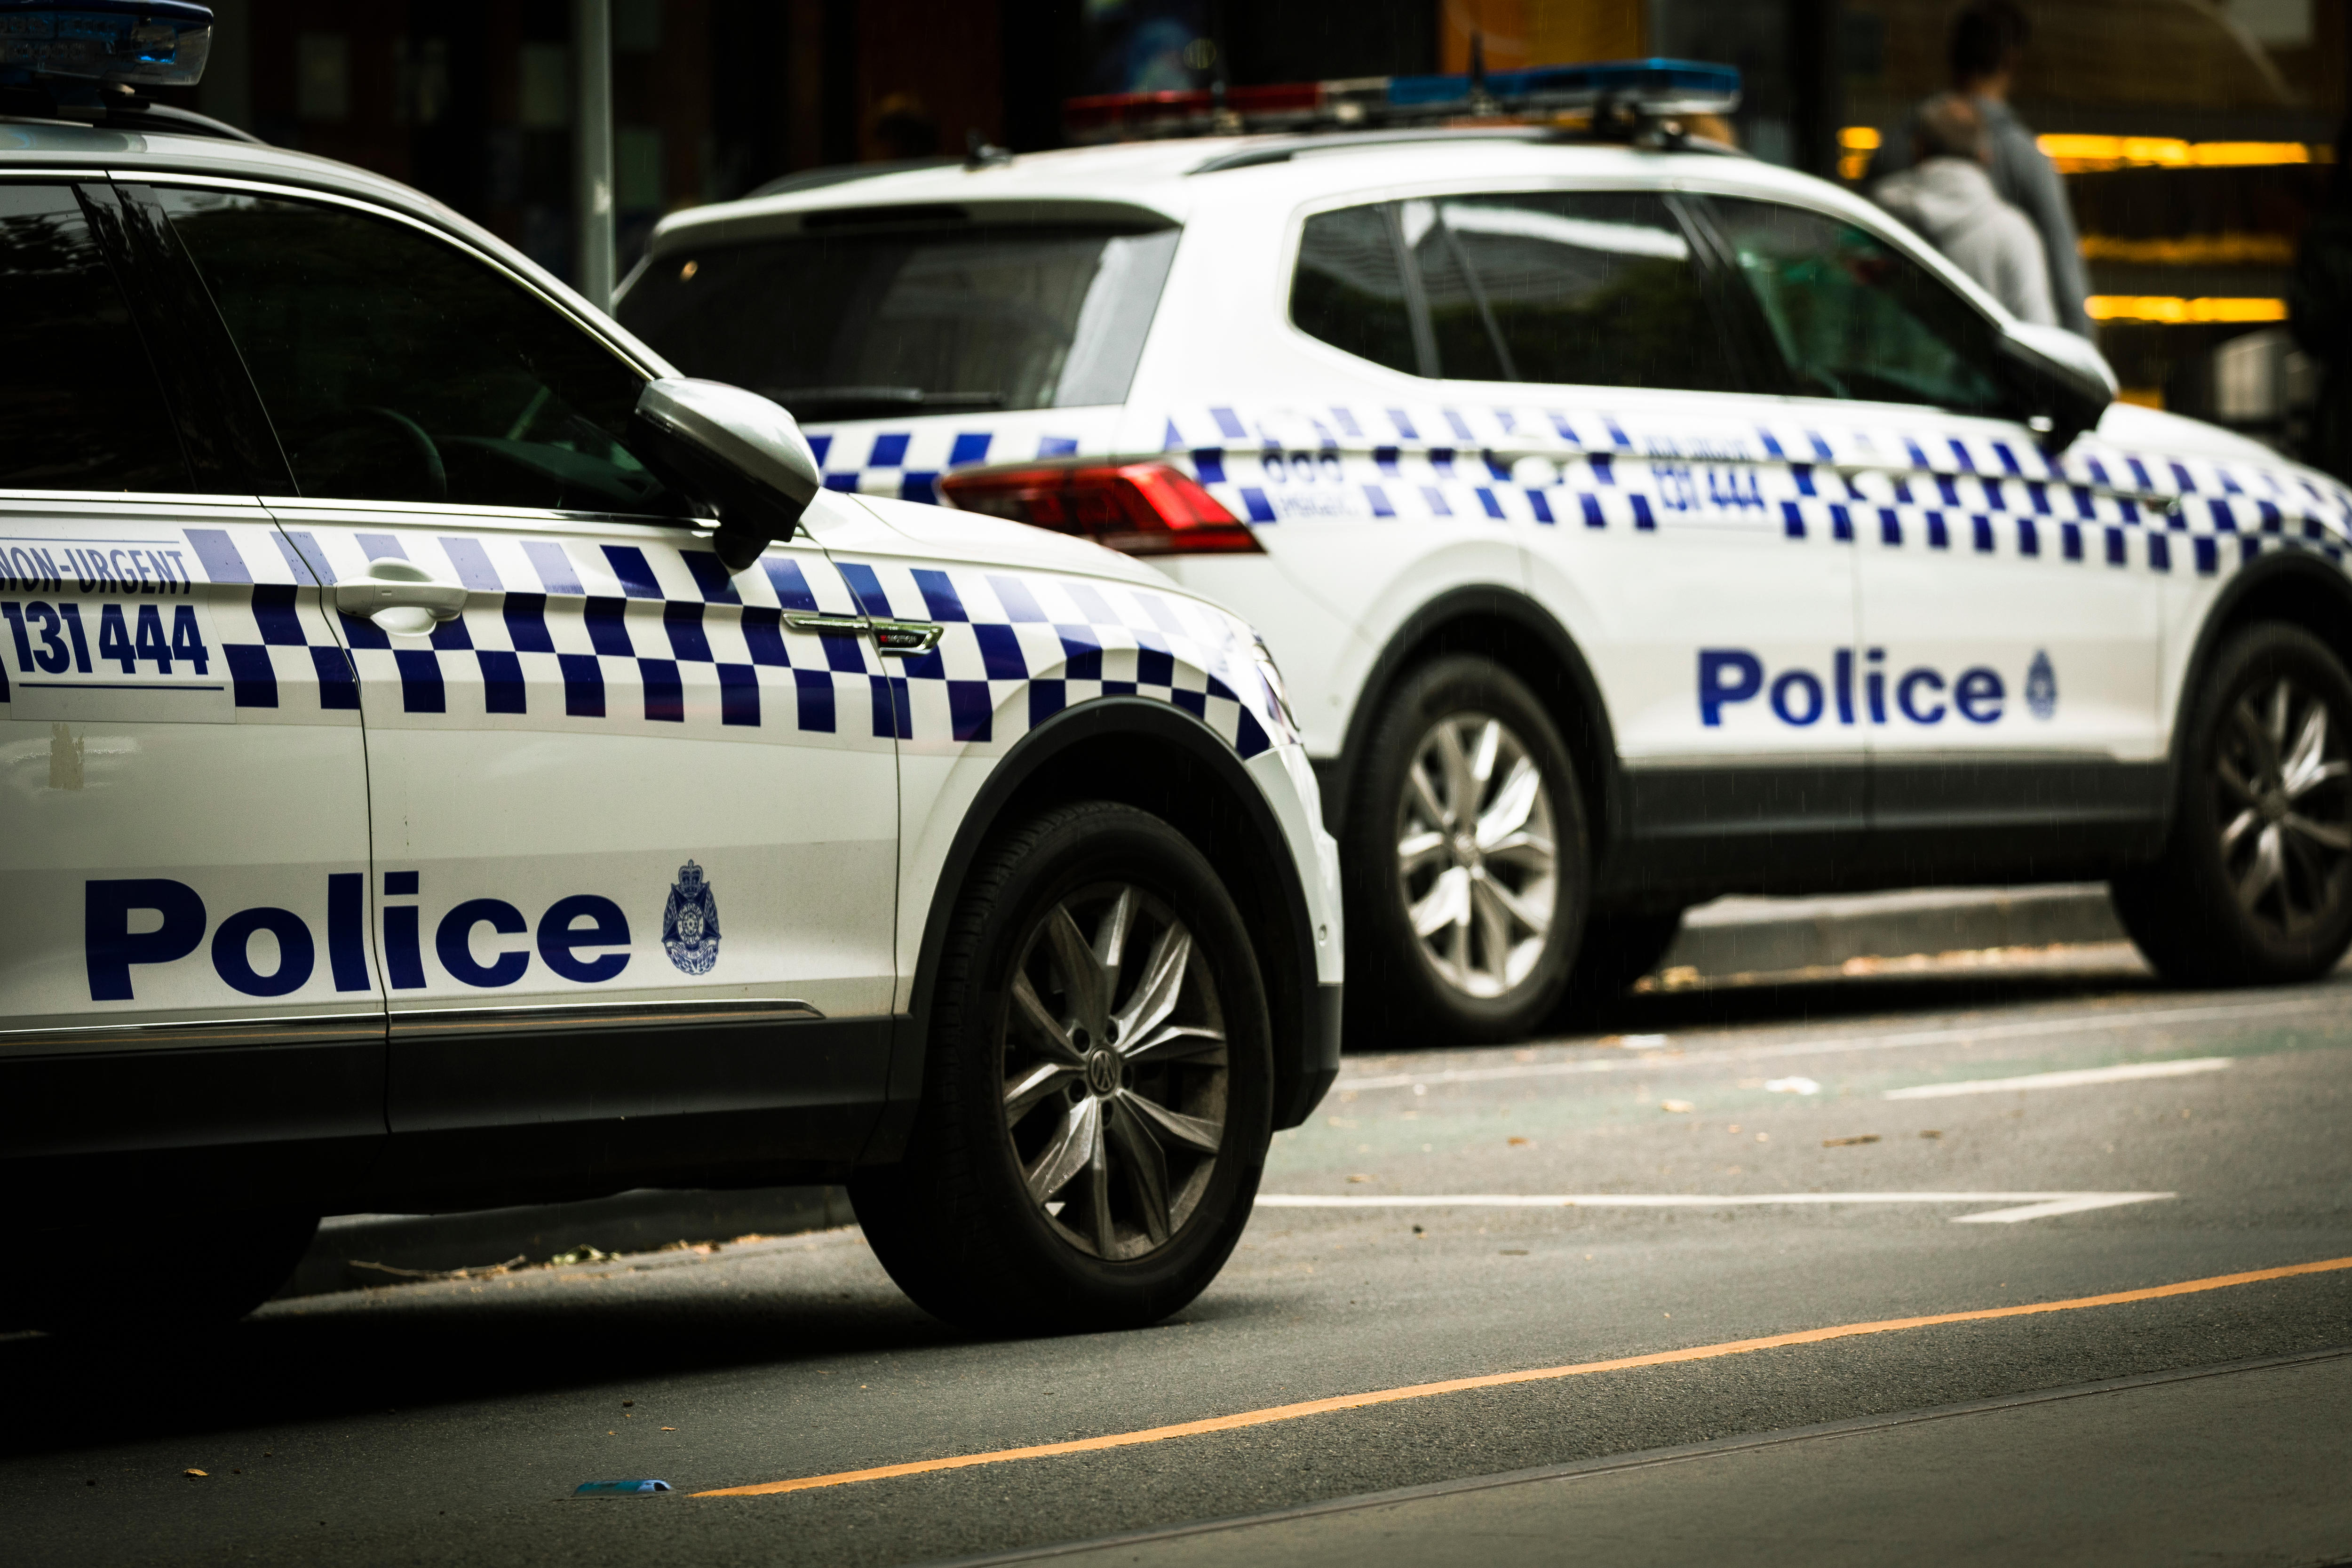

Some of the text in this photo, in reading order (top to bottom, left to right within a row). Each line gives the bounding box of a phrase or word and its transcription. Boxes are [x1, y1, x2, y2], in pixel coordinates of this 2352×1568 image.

[0, 547, 191, 595] NON-URGENT
[0, 601, 209, 675] 131 444
[1697, 646, 2006, 728] Police
[85, 870, 632, 1001] Police
[677, 902, 703, 921] VICTORIA
[680, 931, 701, 945] POLICE
